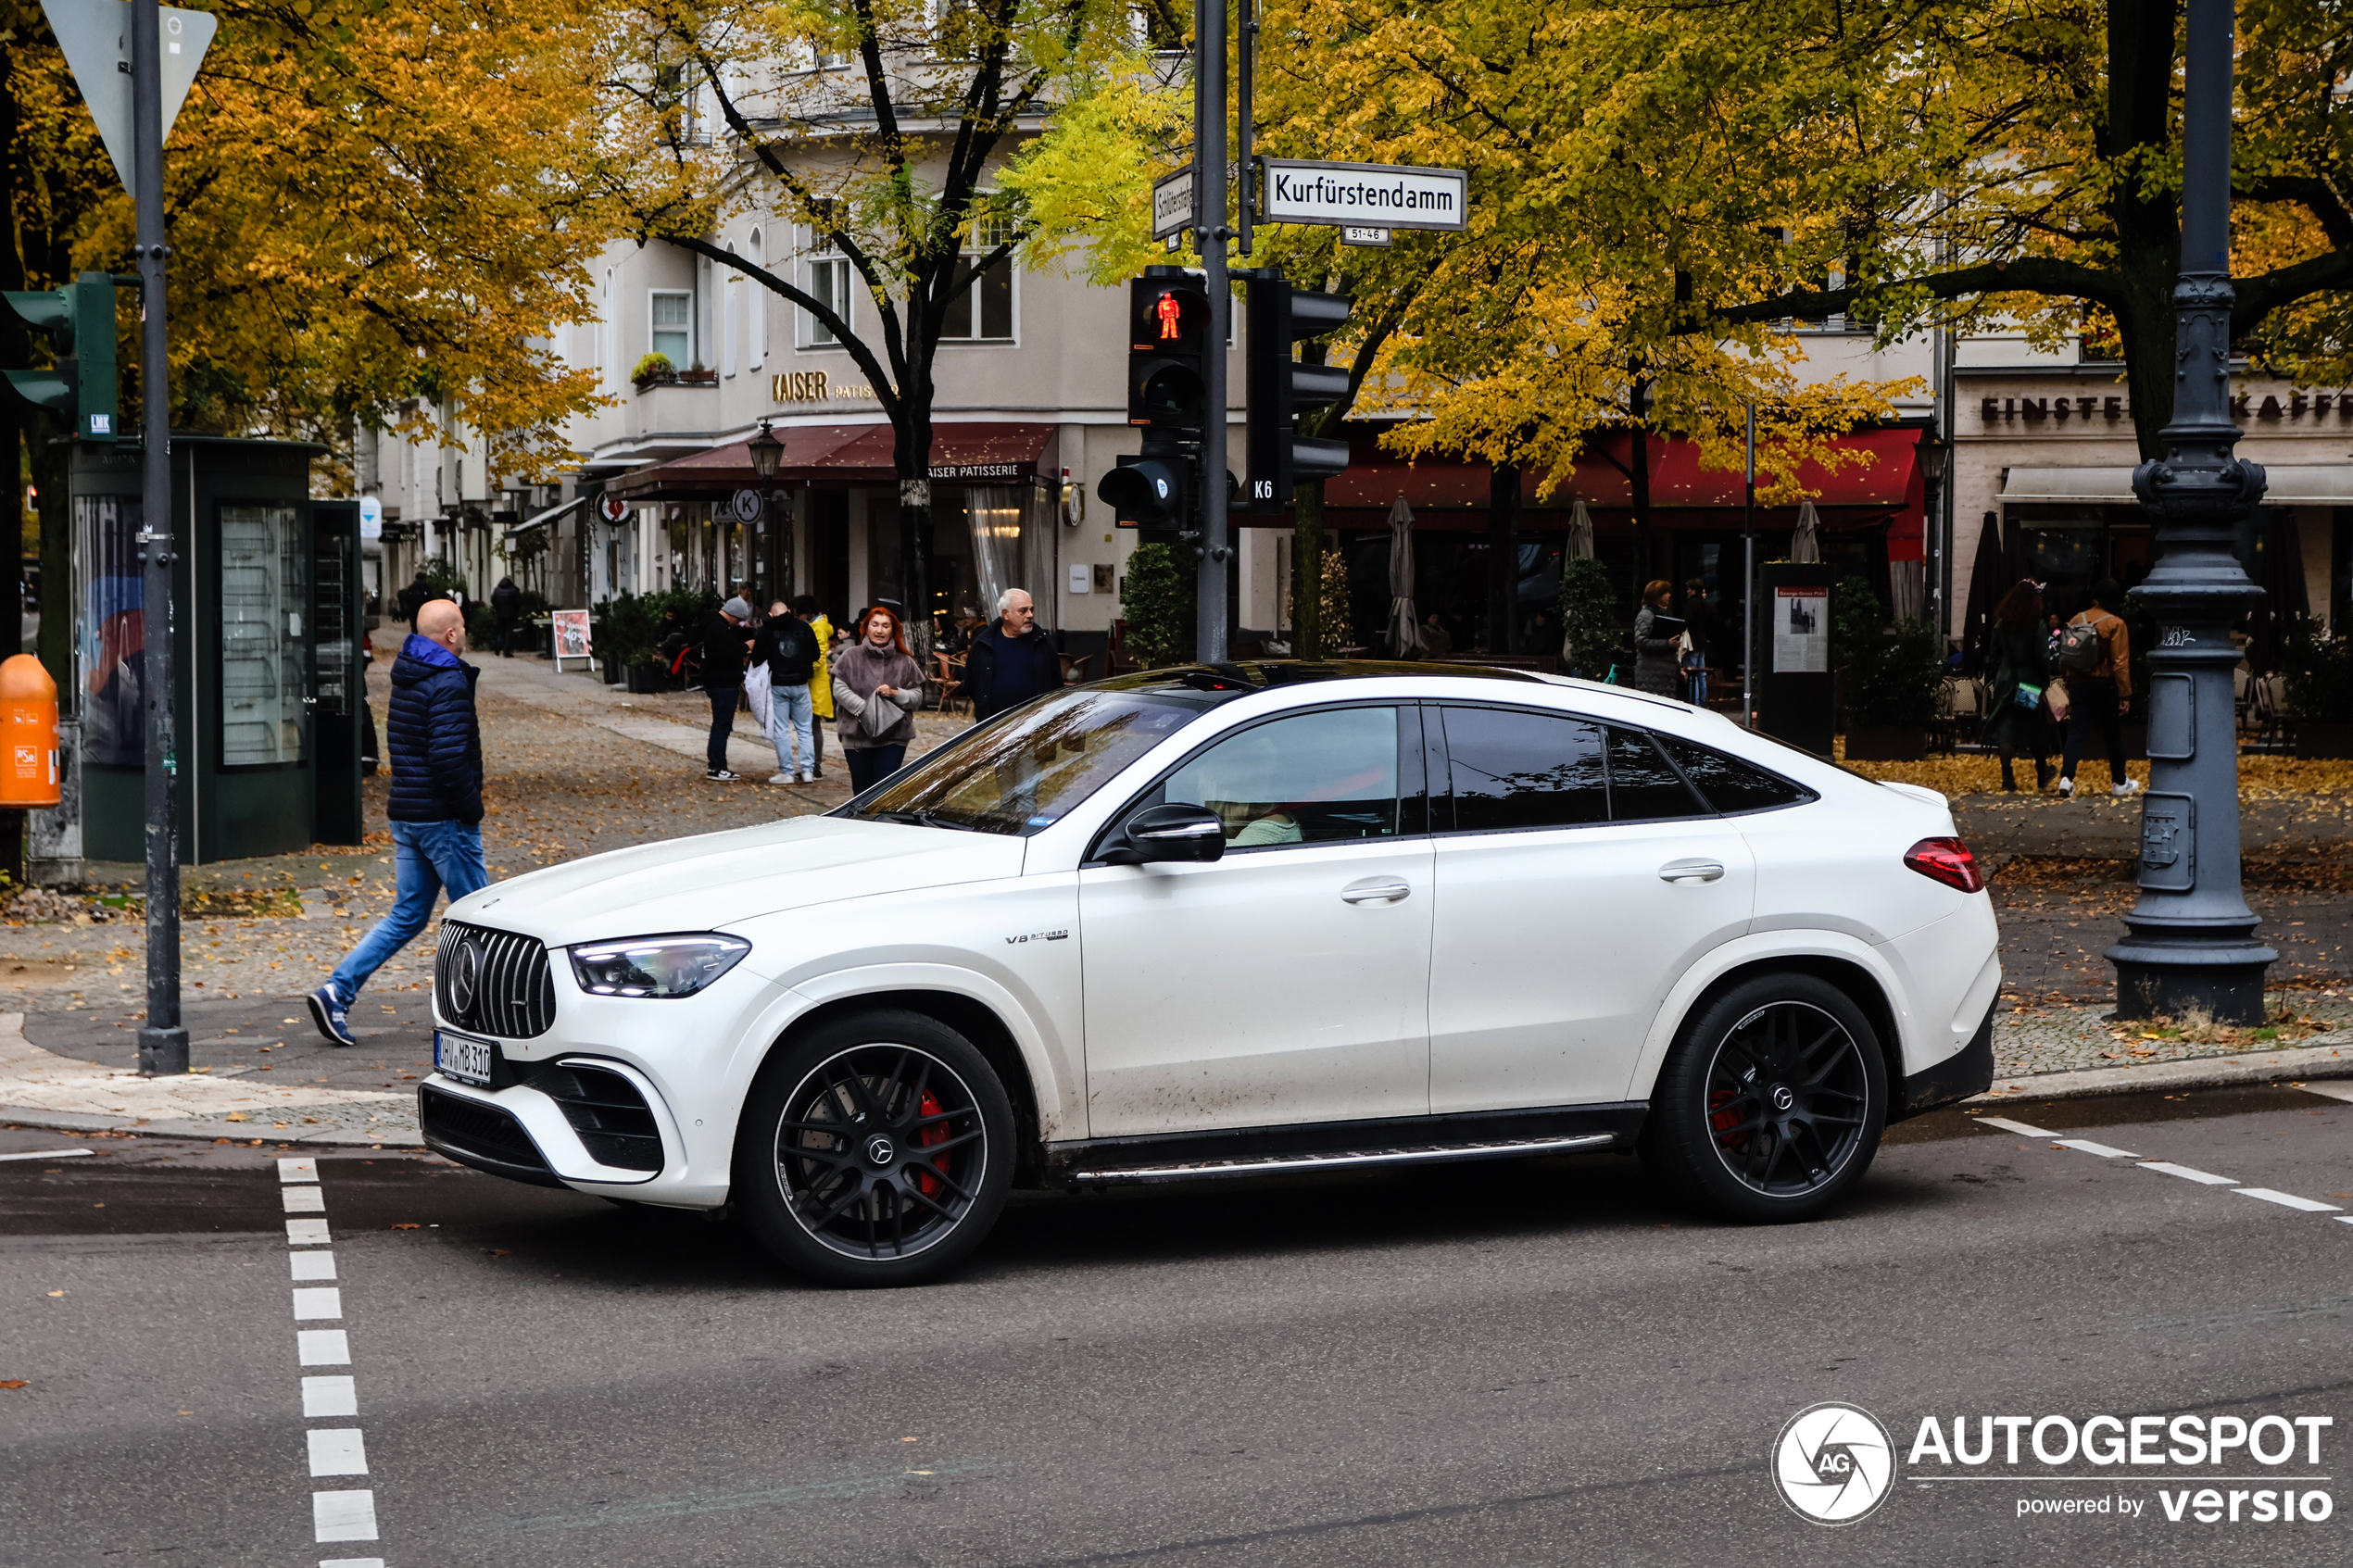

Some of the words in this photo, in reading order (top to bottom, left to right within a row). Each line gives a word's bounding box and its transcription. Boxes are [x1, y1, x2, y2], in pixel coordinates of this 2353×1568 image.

[1276, 173, 1453, 210] Kurfürstendamm
[1352, 229, 1379, 240] 51-46
[772, 371, 828, 403] KAISER
[91, 415, 109, 429] LMK
[928, 467, 956, 478] AISER
[960, 465, 1018, 477] PATISSERIE
[1254, 480, 1273, 499] K6
[742, 496, 753, 513] K
[1071, 495, 1077, 513] K
[17, 749, 35, 763] BSR
[1005, 935, 1028, 944] V8
[1031, 929, 1068, 938] BITURBO
[459, 1042, 471, 1073] MB
[472, 1046, 490, 1076] 310
